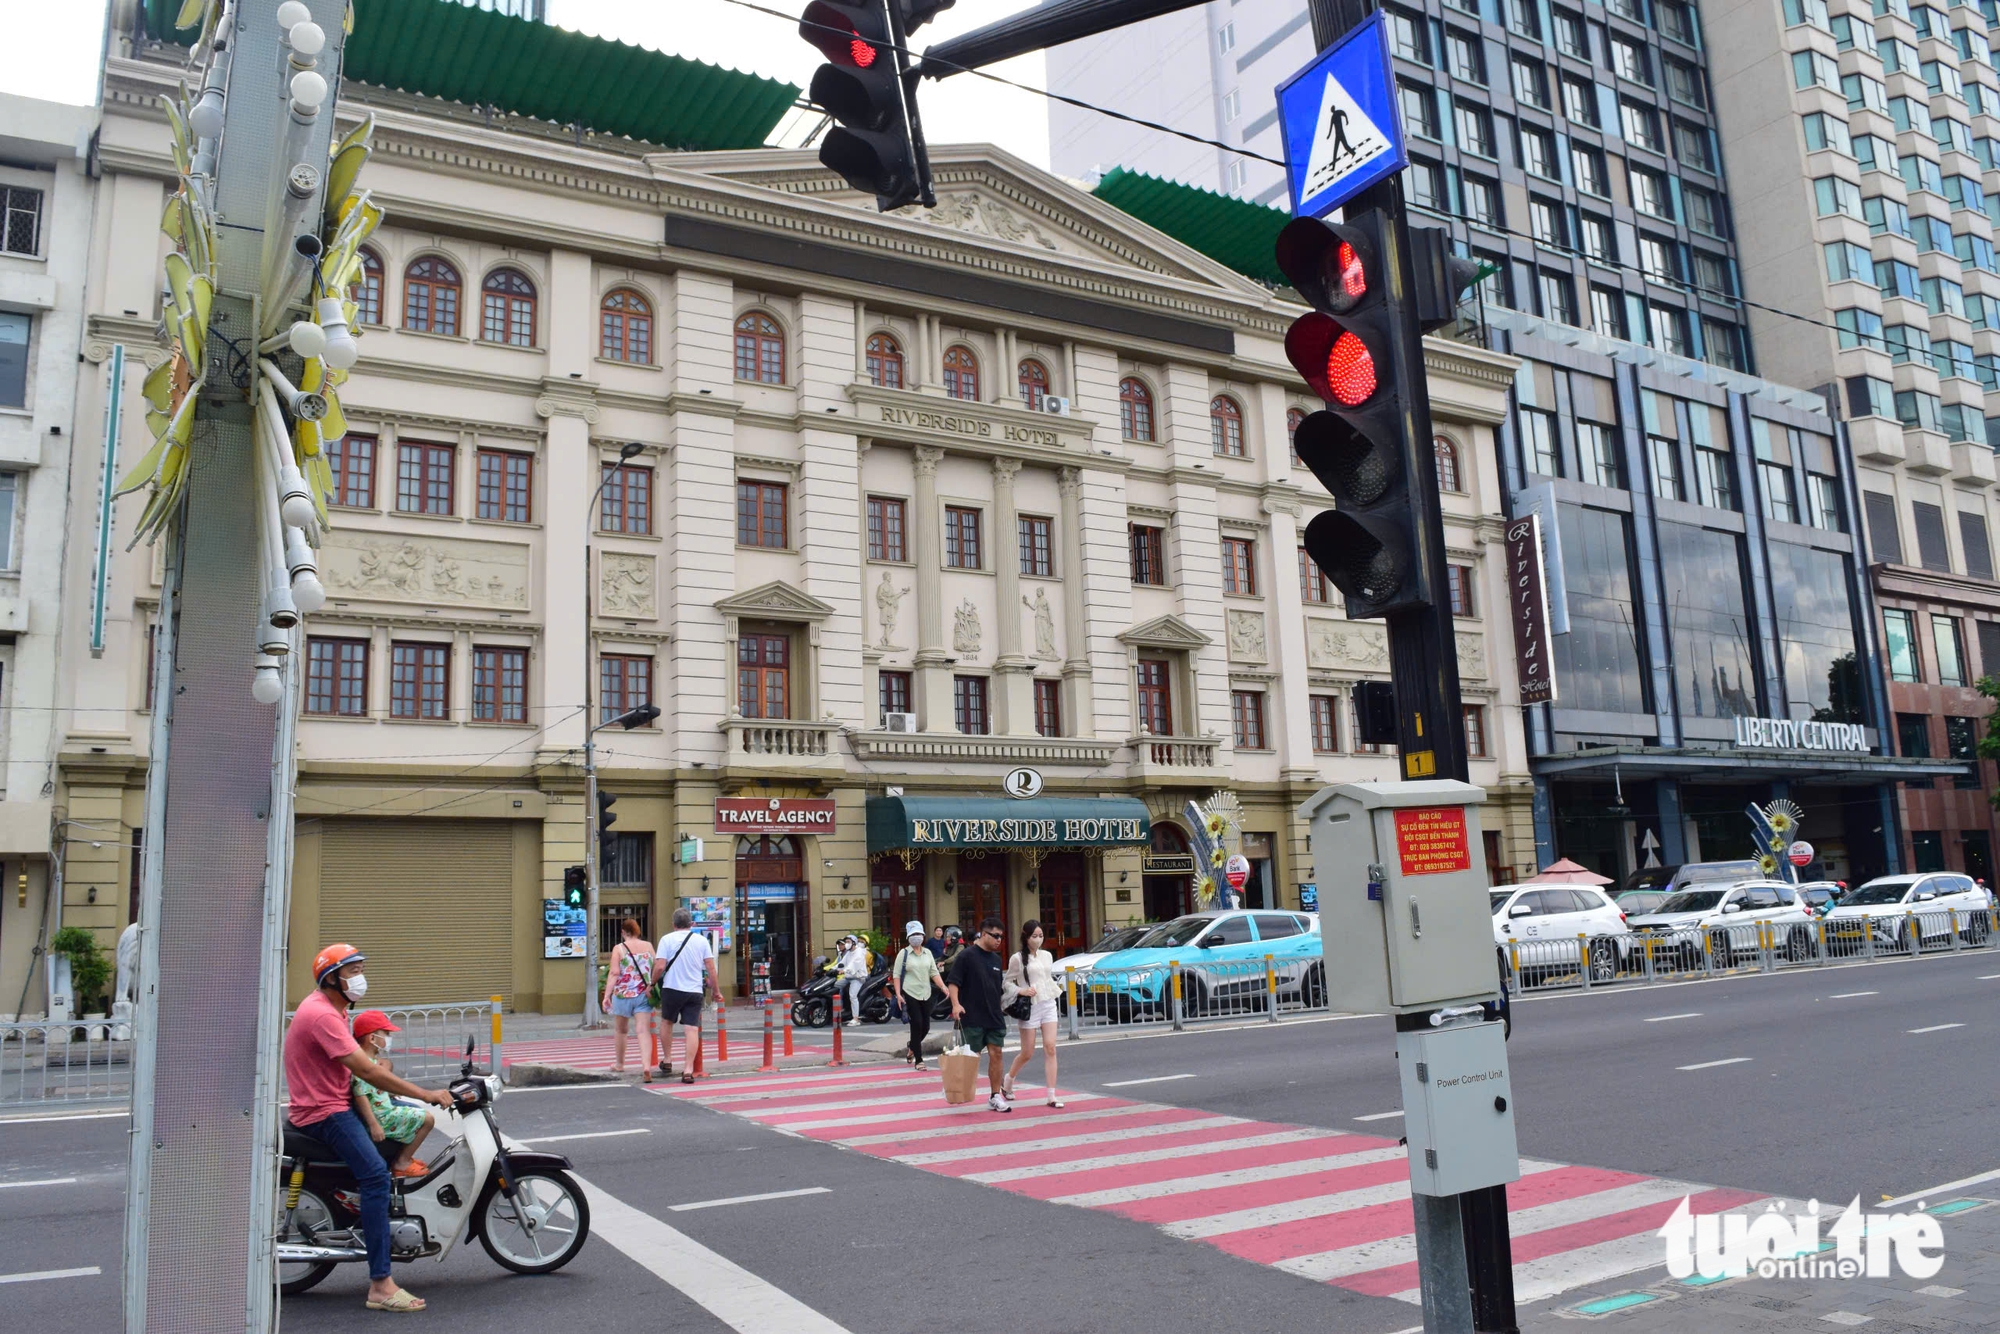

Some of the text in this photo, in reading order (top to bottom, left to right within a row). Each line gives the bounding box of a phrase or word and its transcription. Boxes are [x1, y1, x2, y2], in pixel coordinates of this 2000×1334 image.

[880, 406, 1066, 448] RIVERSIDE HOTEL
[1507, 522, 1538, 675] Riverside
[1519, 677, 1550, 694] Hotel
[1735, 716, 1871, 752] LIBERTY CENTRAL
[1414, 755, 1421, 772] 1
[719, 810, 833, 824] TRAVEL AGENCY
[912, 818, 1147, 843] RIVERSIDE HOTEL
[1415, 833, 1428, 841] CSGT
[1146, 860, 1191, 869] RESTAURANT
[826, 899, 865, 910] 18-19-20
[1436, 1069, 1504, 1089] Power Control Unit
